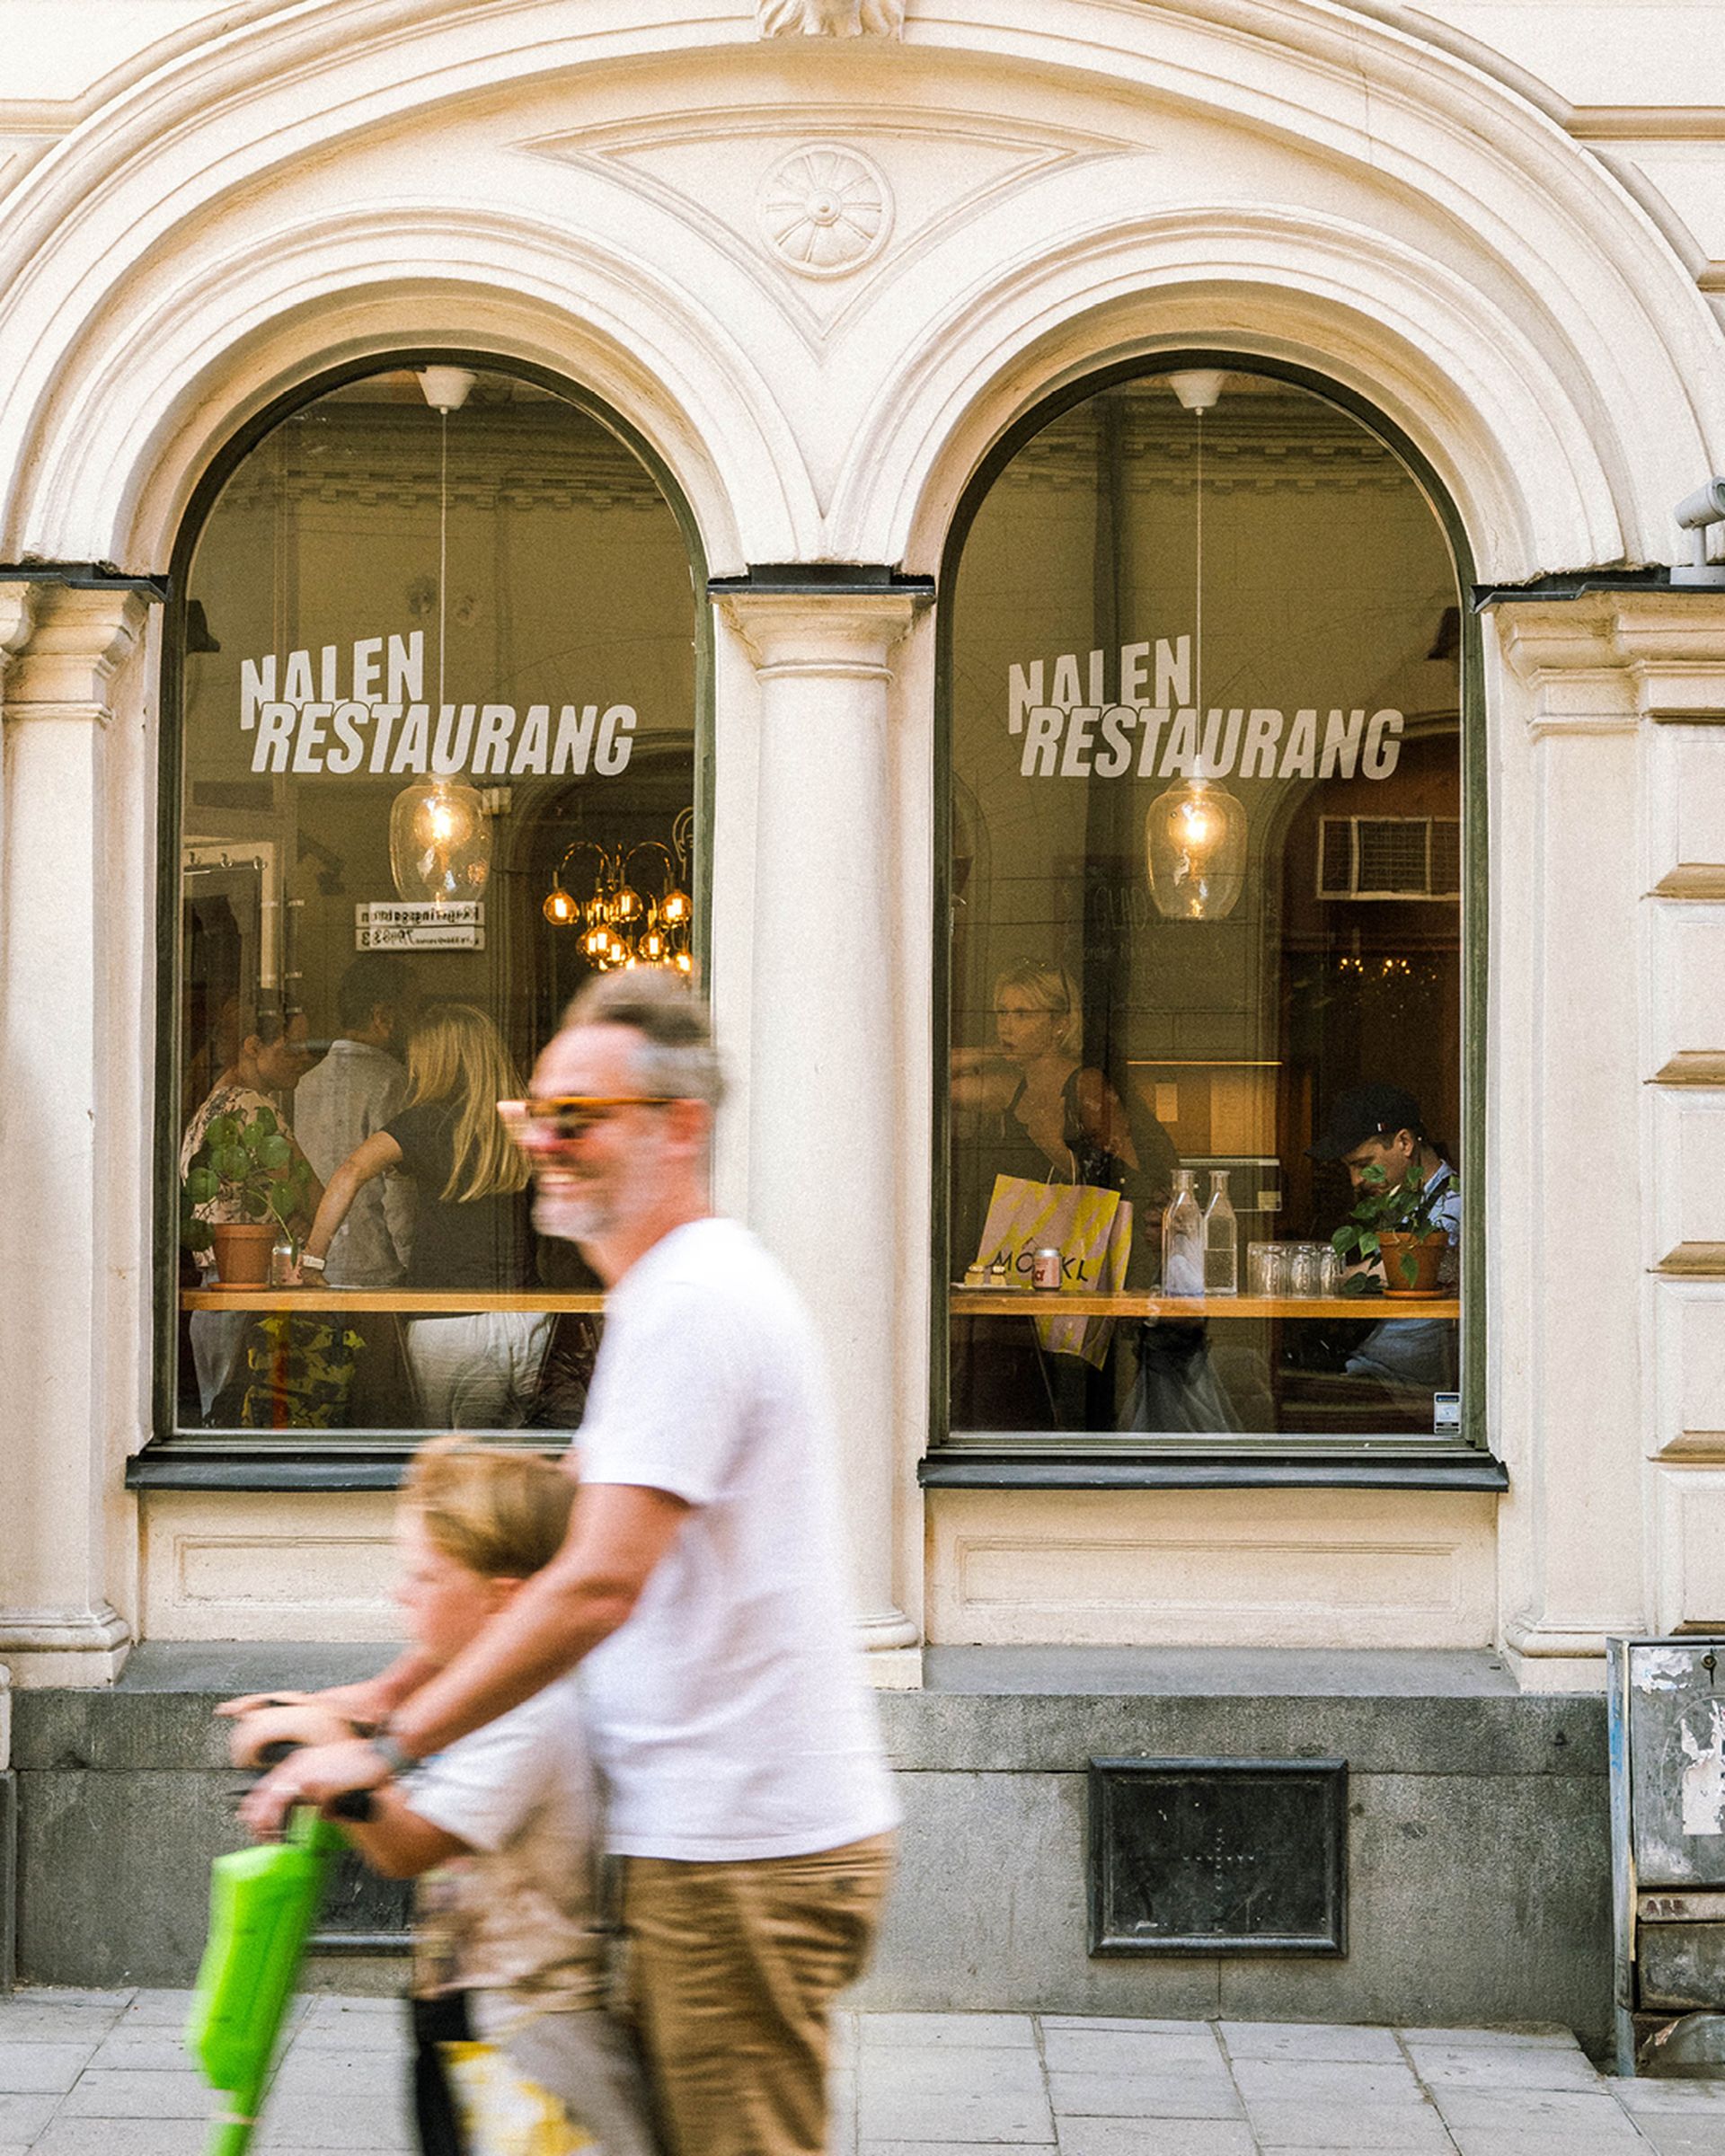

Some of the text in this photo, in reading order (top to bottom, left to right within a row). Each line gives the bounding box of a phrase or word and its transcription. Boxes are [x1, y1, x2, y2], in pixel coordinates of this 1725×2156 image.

[240, 630, 424, 730] NALEN
[1008, 635, 1191, 735] NALEN
[251, 702, 637, 776] RESTAURANG
[1020, 705, 1405, 781] RESTAURANG
